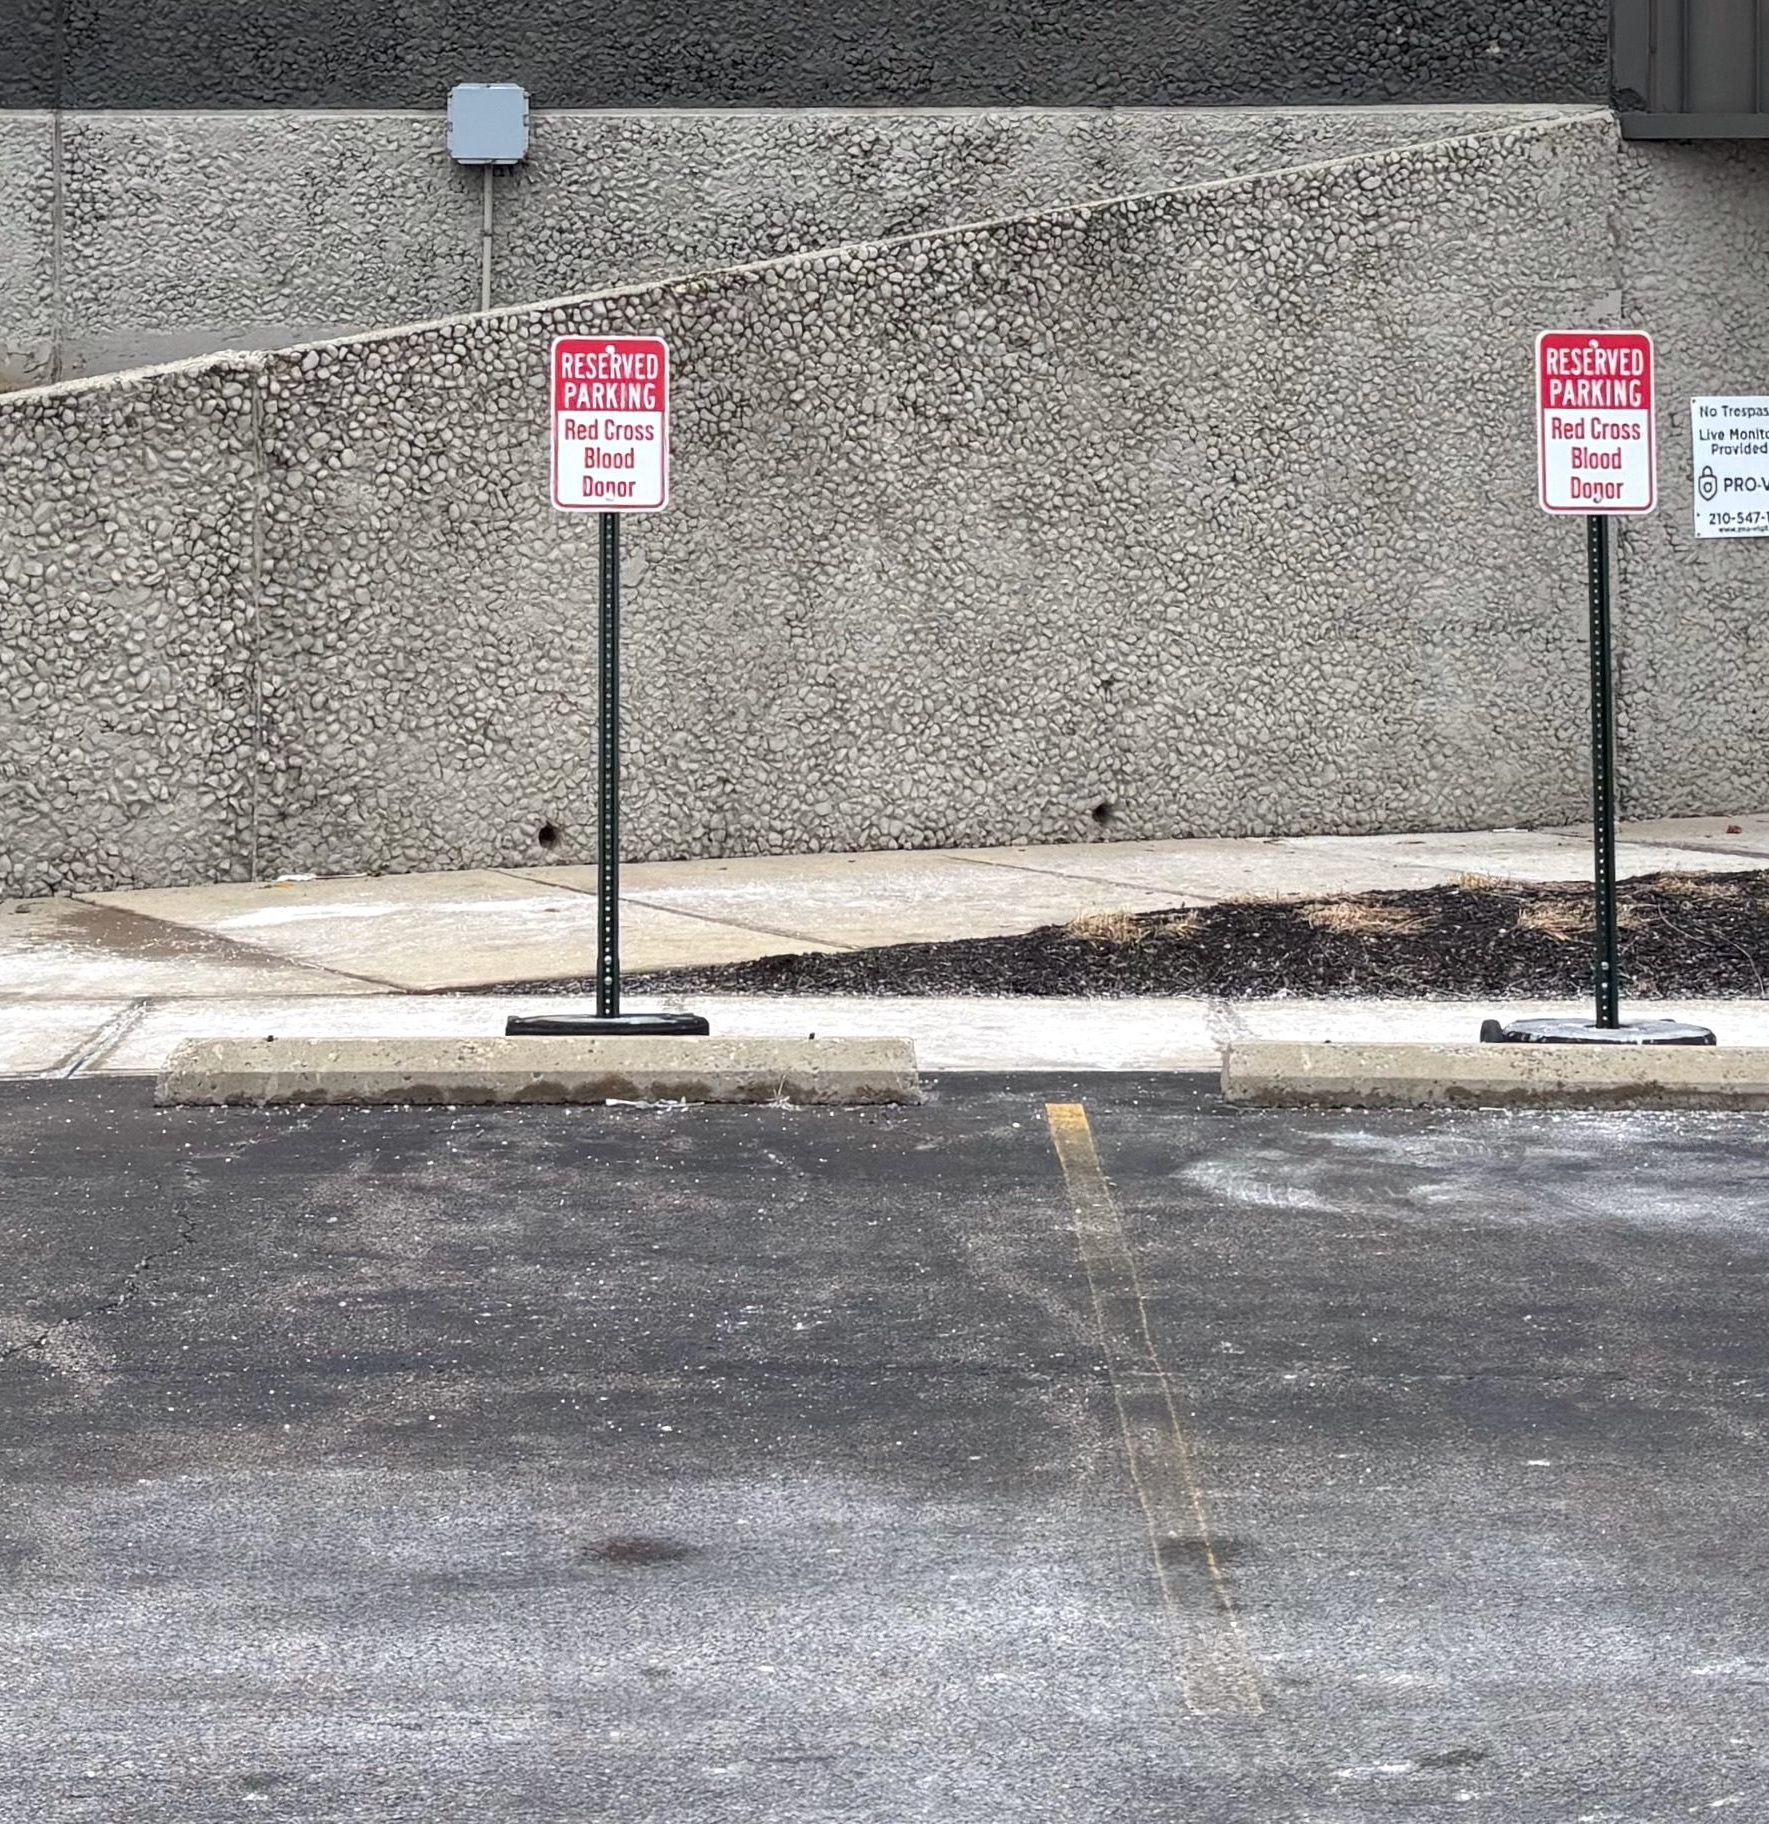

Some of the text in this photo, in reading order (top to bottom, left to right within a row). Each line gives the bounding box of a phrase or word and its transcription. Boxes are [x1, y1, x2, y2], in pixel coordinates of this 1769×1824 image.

[562, 353, 658, 379] RESERVED
[1546, 348, 1643, 375] RESERVED
[564, 382, 656, 409] PARKING
[1549, 379, 1641, 407] PARKING
[1700, 406, 1717, 417] No
[565, 419, 654, 441] Red Cross
[1552, 417, 1641, 440] Red Cross
[1699, 429, 1725, 440] Live
[584, 447, 634, 469] Blood
[1571, 447, 1622, 469] Blood
[1711, 442, 1768, 455] Provided
[583, 476, 636, 497] Donor
[1571, 477, 1624, 499] Donor
